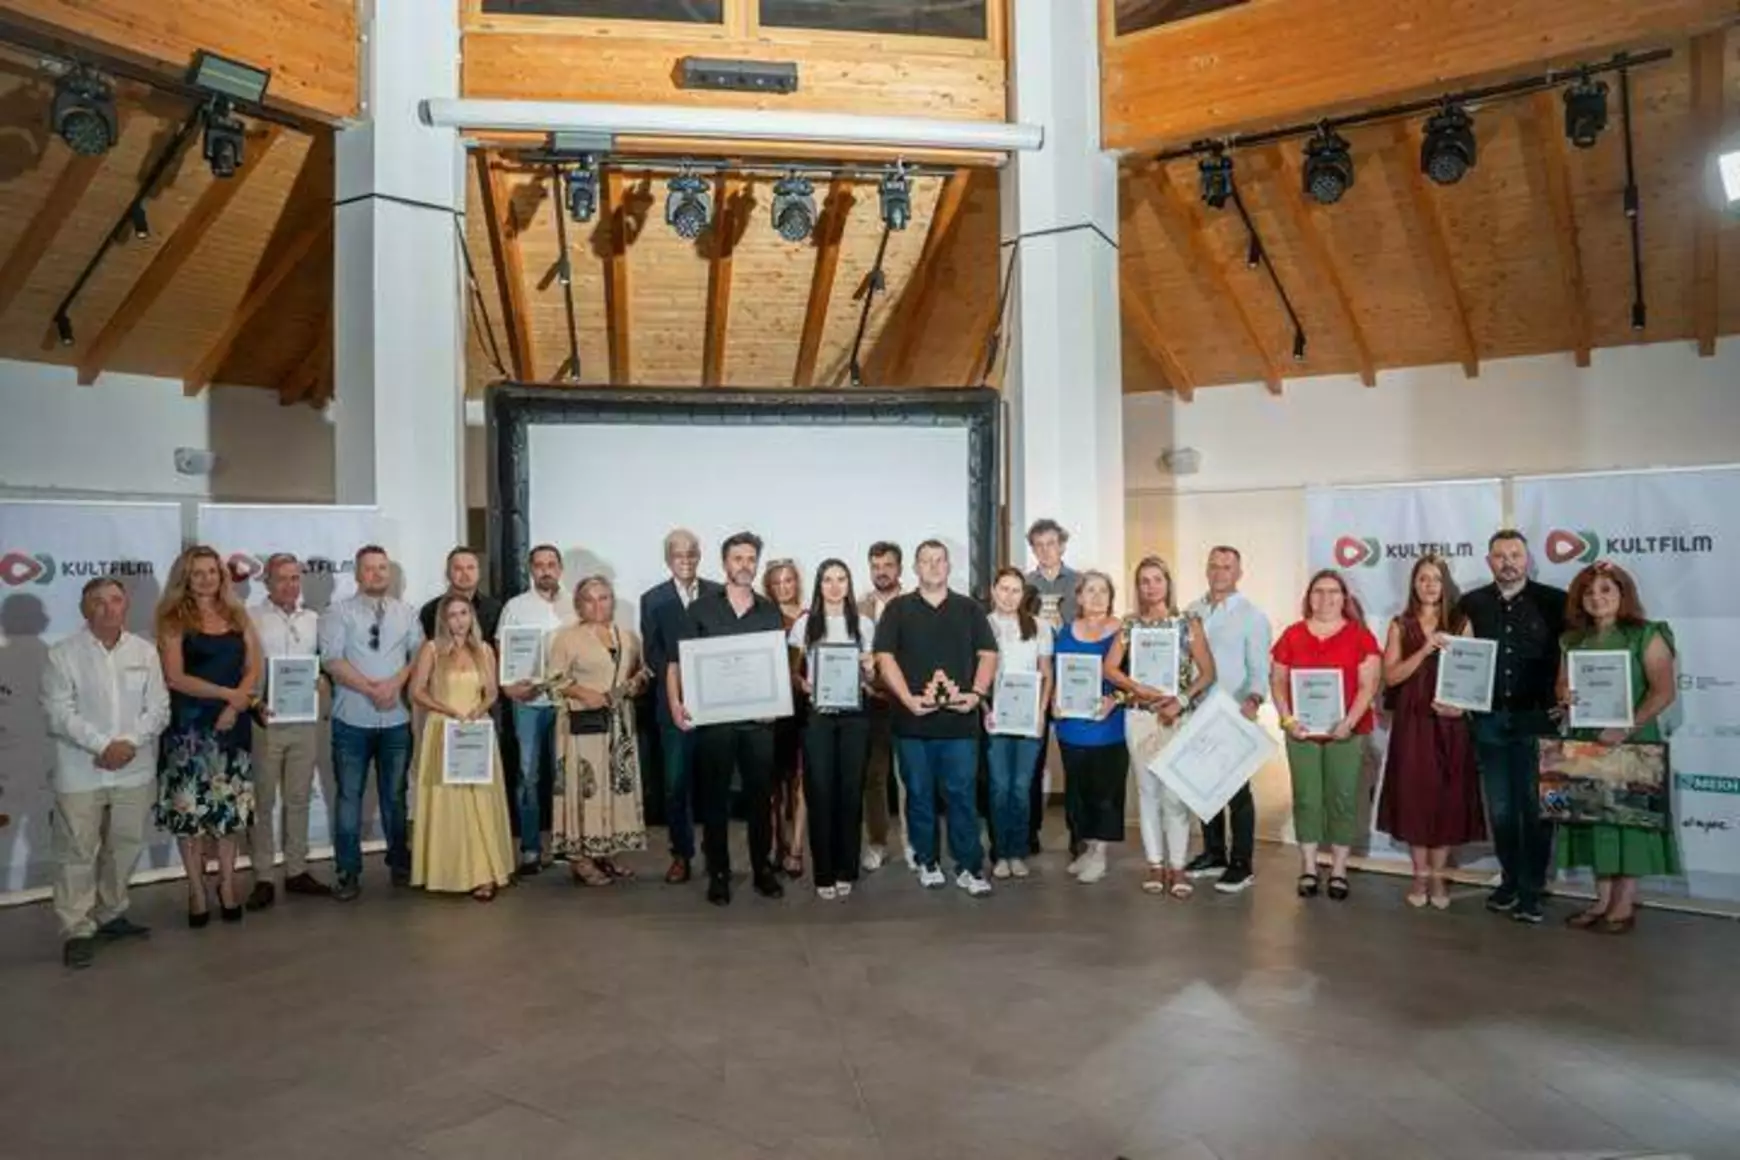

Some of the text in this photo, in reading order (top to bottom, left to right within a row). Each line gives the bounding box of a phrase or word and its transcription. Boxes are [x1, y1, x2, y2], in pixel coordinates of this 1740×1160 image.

[1386, 541, 1473, 558] KULTFILM
[1606, 535, 1712, 554] KULTFILM
[62, 560, 154, 576] KULTFILM
